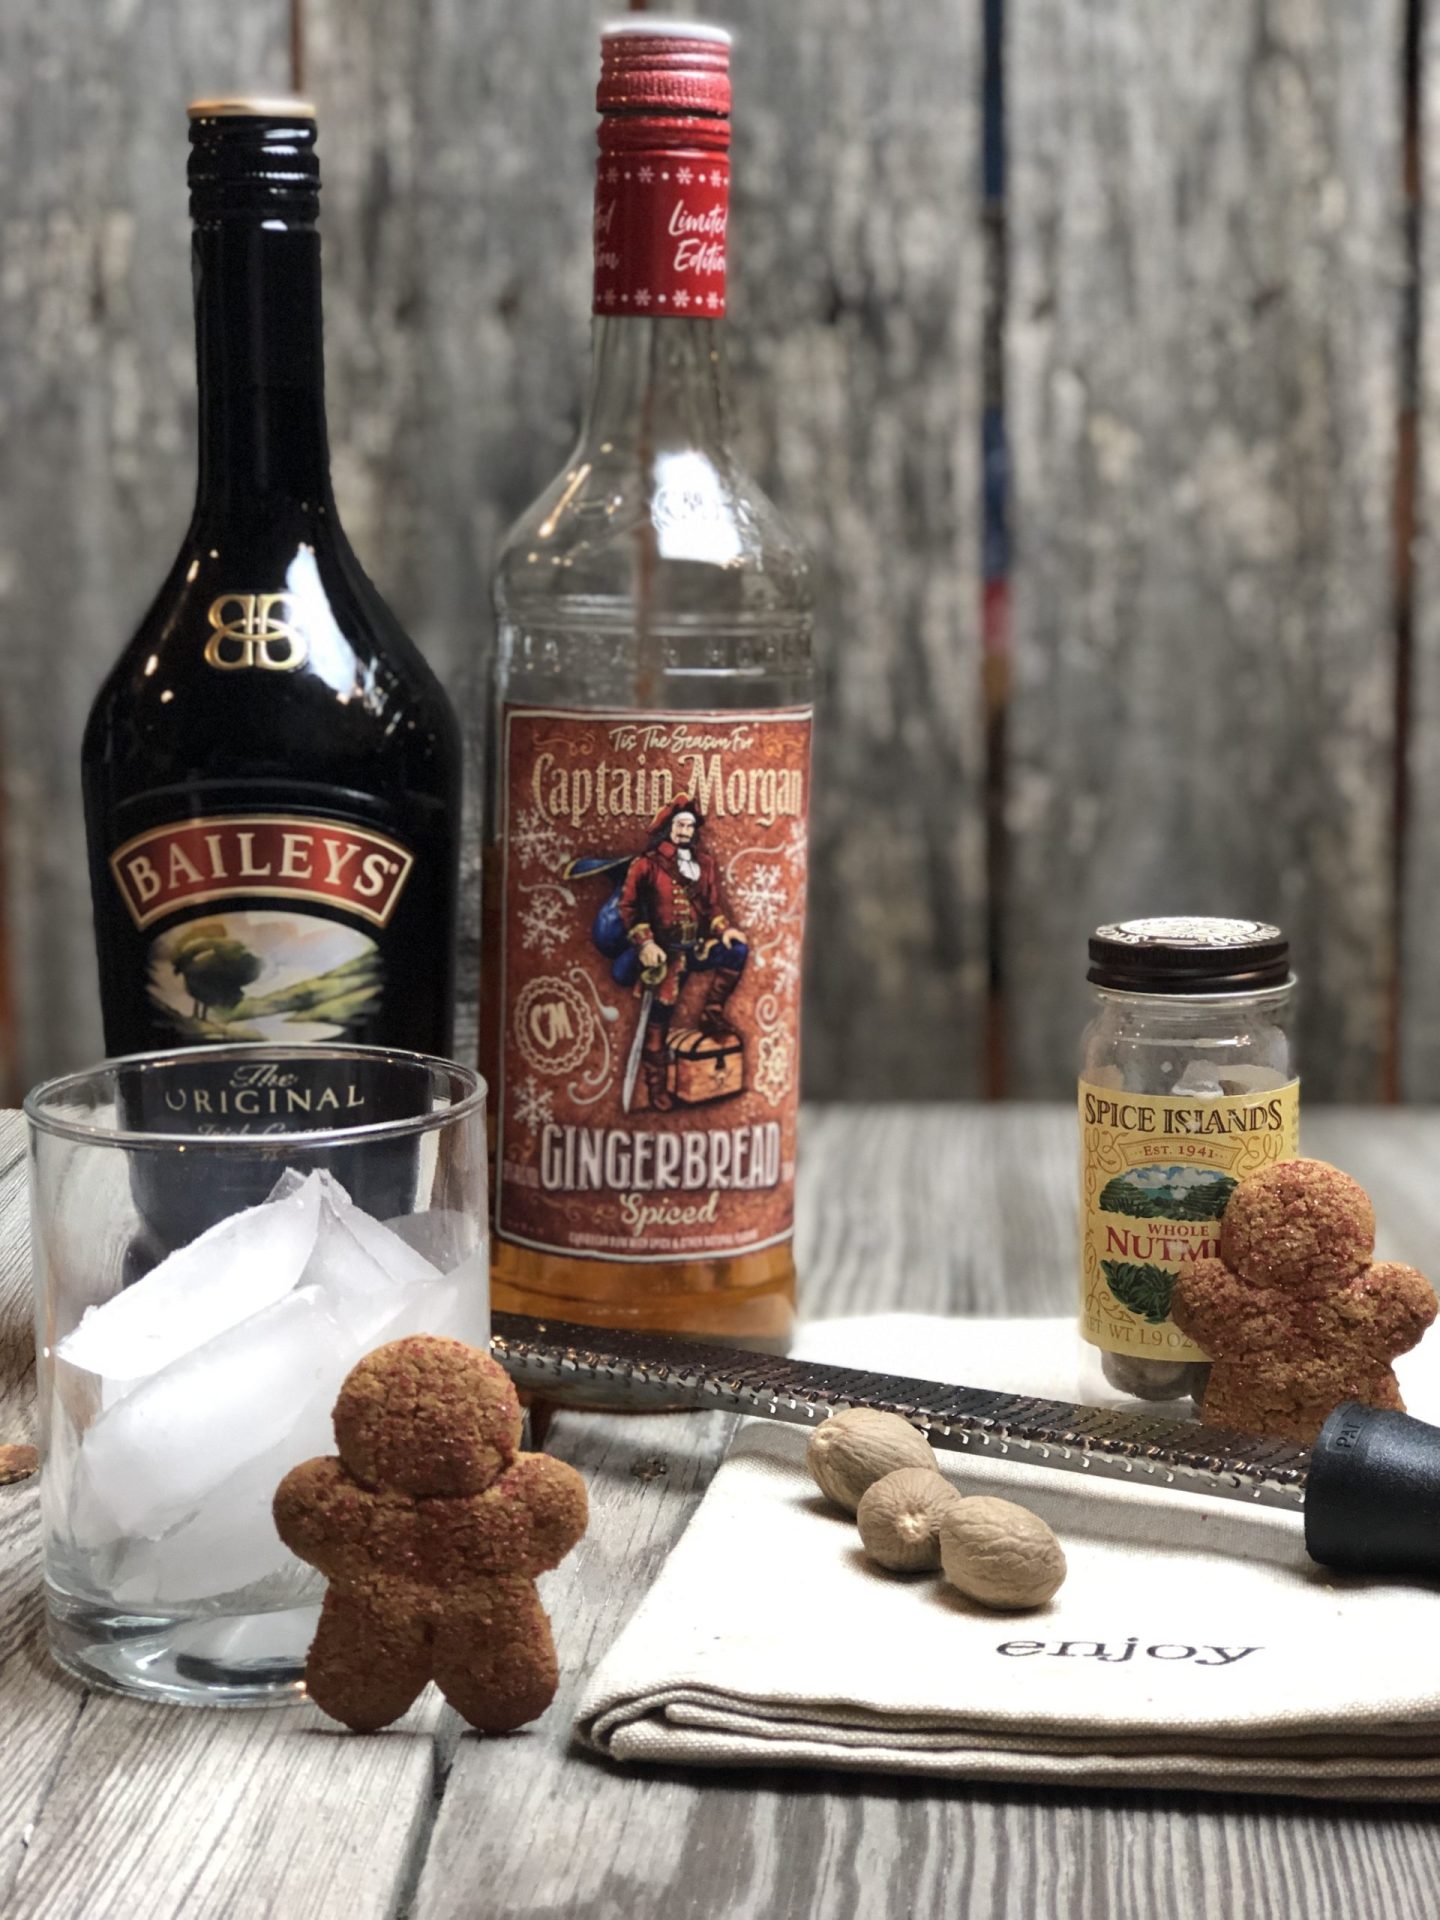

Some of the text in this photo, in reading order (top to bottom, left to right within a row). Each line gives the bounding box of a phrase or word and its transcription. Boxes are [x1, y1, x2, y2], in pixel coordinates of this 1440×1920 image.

[637, 725, 671, 751] The
[670, 725, 732, 753] Season
[531, 752, 803, 828] Captain Morgan
[127, 832, 391, 902] BAILEYS
[229, 1063, 297, 1088] The
[165, 1085, 365, 1115] ORIGINAL
[1085, 1092, 1156, 1133] SPICE
[1163, 1099, 1282, 1134] ISLANDS
[541, 1121, 779, 1192] GINGERBREAD
[1178, 1145, 1214, 1158] 1941
[620, 1190, 719, 1236] Spiced
[1148, 1223, 1209, 1237] WHOLE
[1108, 1323, 1132, 1342] WT
[996, 1637, 1266, 1666] enjoy
